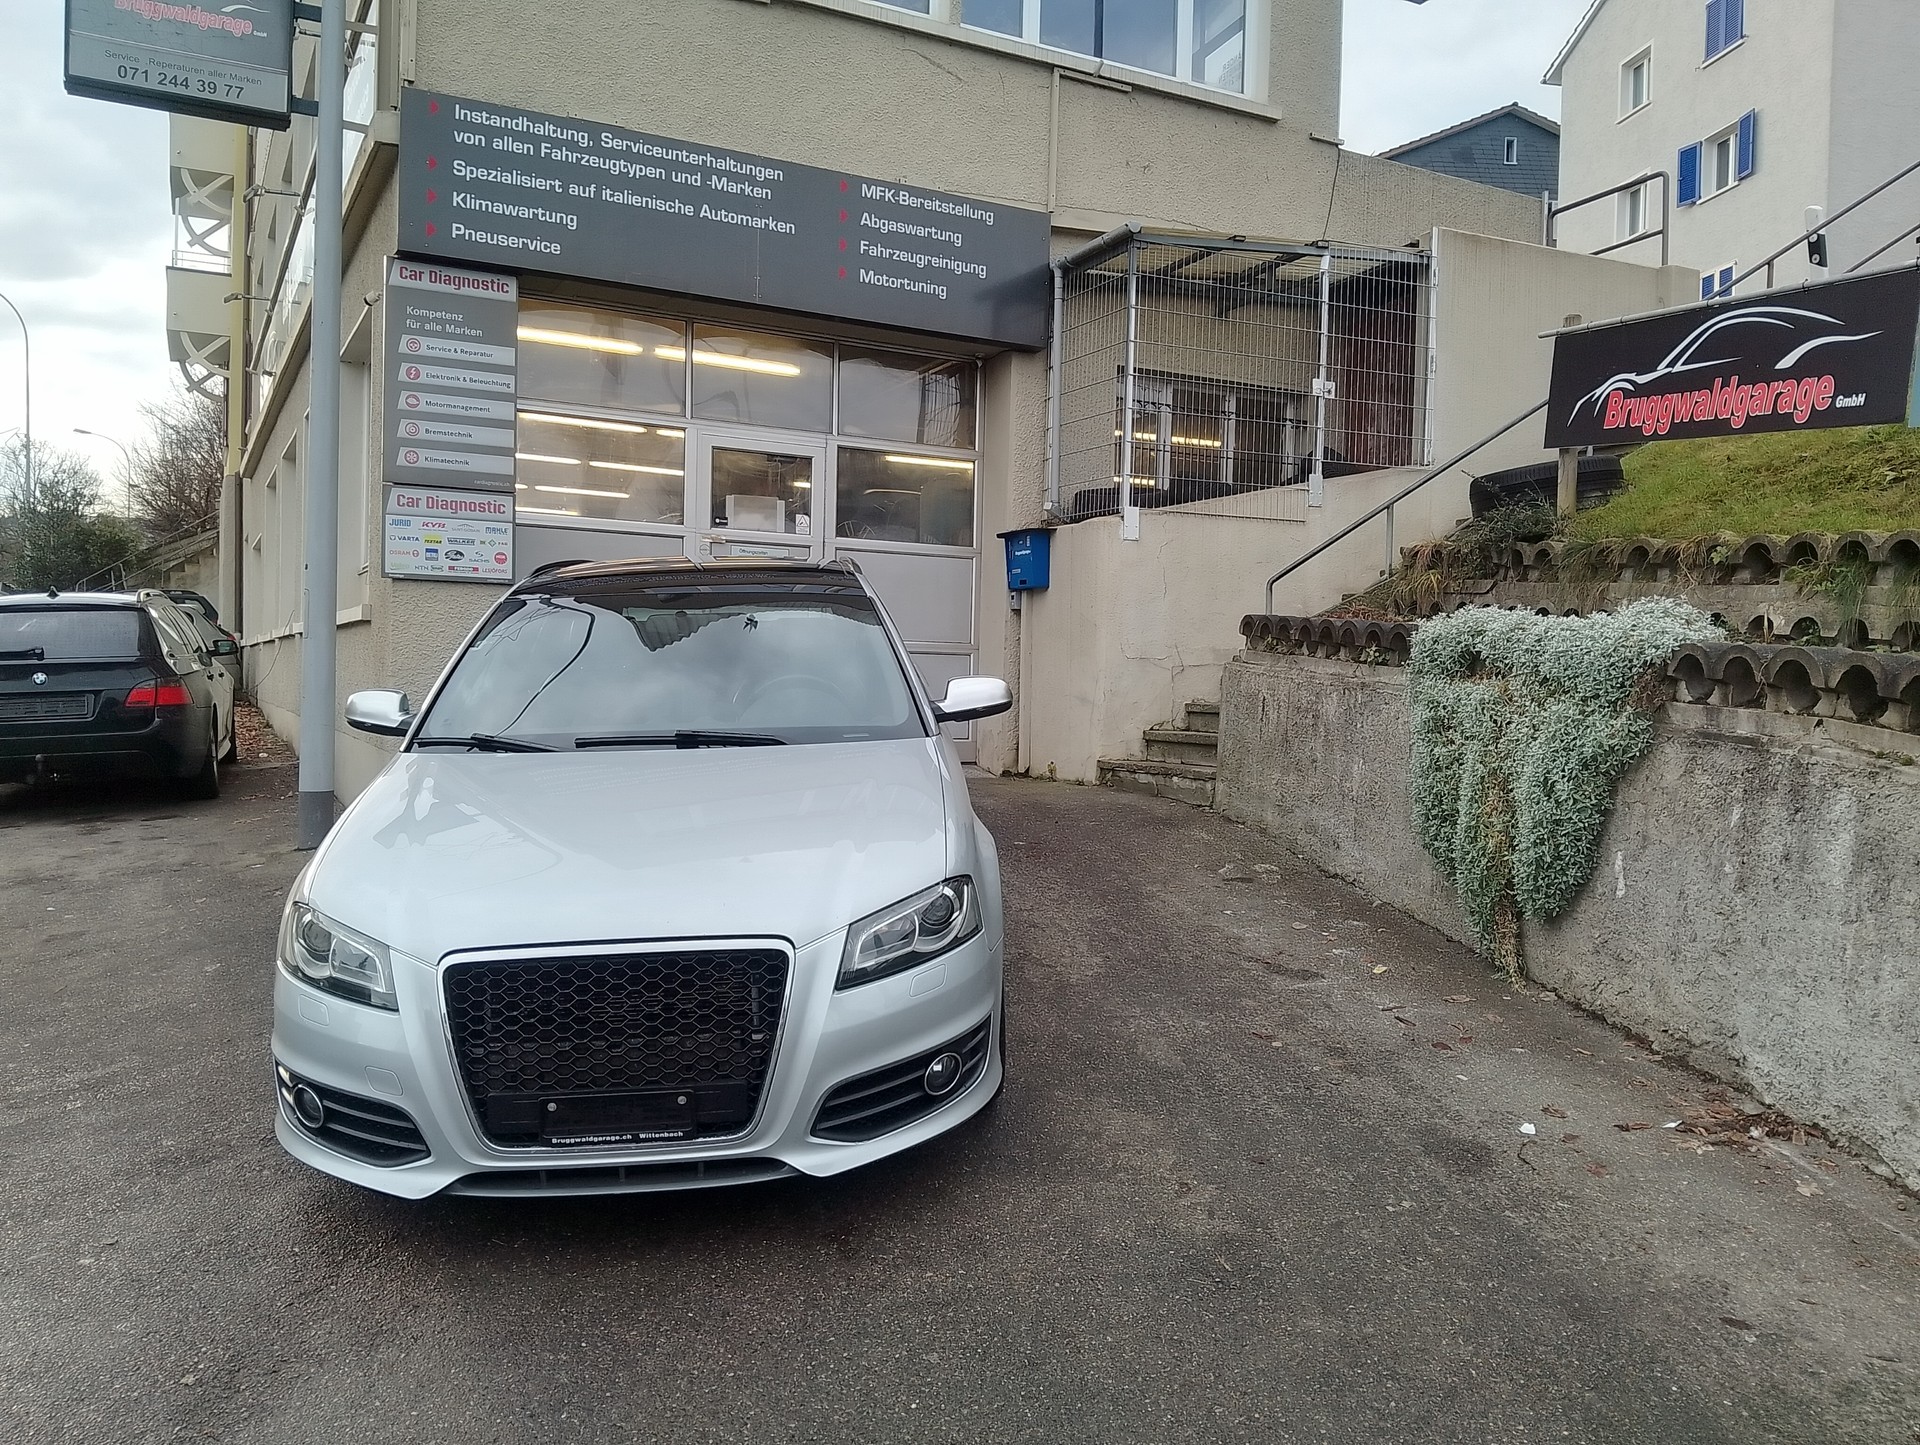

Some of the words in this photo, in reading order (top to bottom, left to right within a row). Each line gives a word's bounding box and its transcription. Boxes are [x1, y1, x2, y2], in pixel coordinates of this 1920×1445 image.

[105, 49, 140, 63] Service
[207, 69, 227, 79] aller
[229, 72, 262, 86] Marken
[117, 65, 149, 83] 071
[157, 72, 190, 90] 244
[196, 79, 218, 95] 39
[223, 83, 245, 99] 77
[453, 103, 594, 148] Instandhaltung,
[600, 132, 784, 183] Serviceunterhaltungen
[453, 129, 486, 148] von
[492, 136, 534, 156] allen
[540, 143, 666, 181] Fahrzeugtypen
[671, 166, 701, 187] und
[706, 174, 773, 200] -Marken
[451, 191, 578, 230] Klimawartung
[452, 159, 563, 194] Spezialisiert
[568, 181, 597, 199] auf
[601, 185, 695, 217] italienische
[699, 203, 796, 235] Automarken
[861, 183, 995, 226] MFK-Bereitstellung
[451, 222, 562, 255] Pneuservice
[860, 212, 962, 247] Abgaswartung
[859, 240, 987, 279] Fahrzeugreinigung
[399, 266, 424, 282] Car
[429, 269, 510, 294] Diagnostic
[859, 268, 947, 300] Motortuning
[406, 306, 464, 322] Kompetenz
[406, 319, 421, 329] für
[424, 321, 443, 332] alle
[445, 323, 483, 337] Marken
[426, 344, 452, 354] Service
[460, 348, 494, 359] Reparatur
[426, 372, 461, 382] Elektronik
[469, 377, 511, 389] Beleuchtung
[425, 400, 491, 413] Motormanagement
[1603, 374, 1835, 436] Bruggwaldgarage
[1836, 392, 1867, 408] GmbH
[425, 428, 473, 439] Bremstechnik
[424, 456, 470, 466] Klimatechnik
[396, 493, 421, 508] Car
[426, 495, 507, 515] Diagnostic
[389, 519, 411, 527] JURID
[485, 527, 508, 535] MAHLE
[551, 1133, 632, 1144] Bruggwaldgarage.ch
[639, 1131, 683, 1139] Wittenbach
